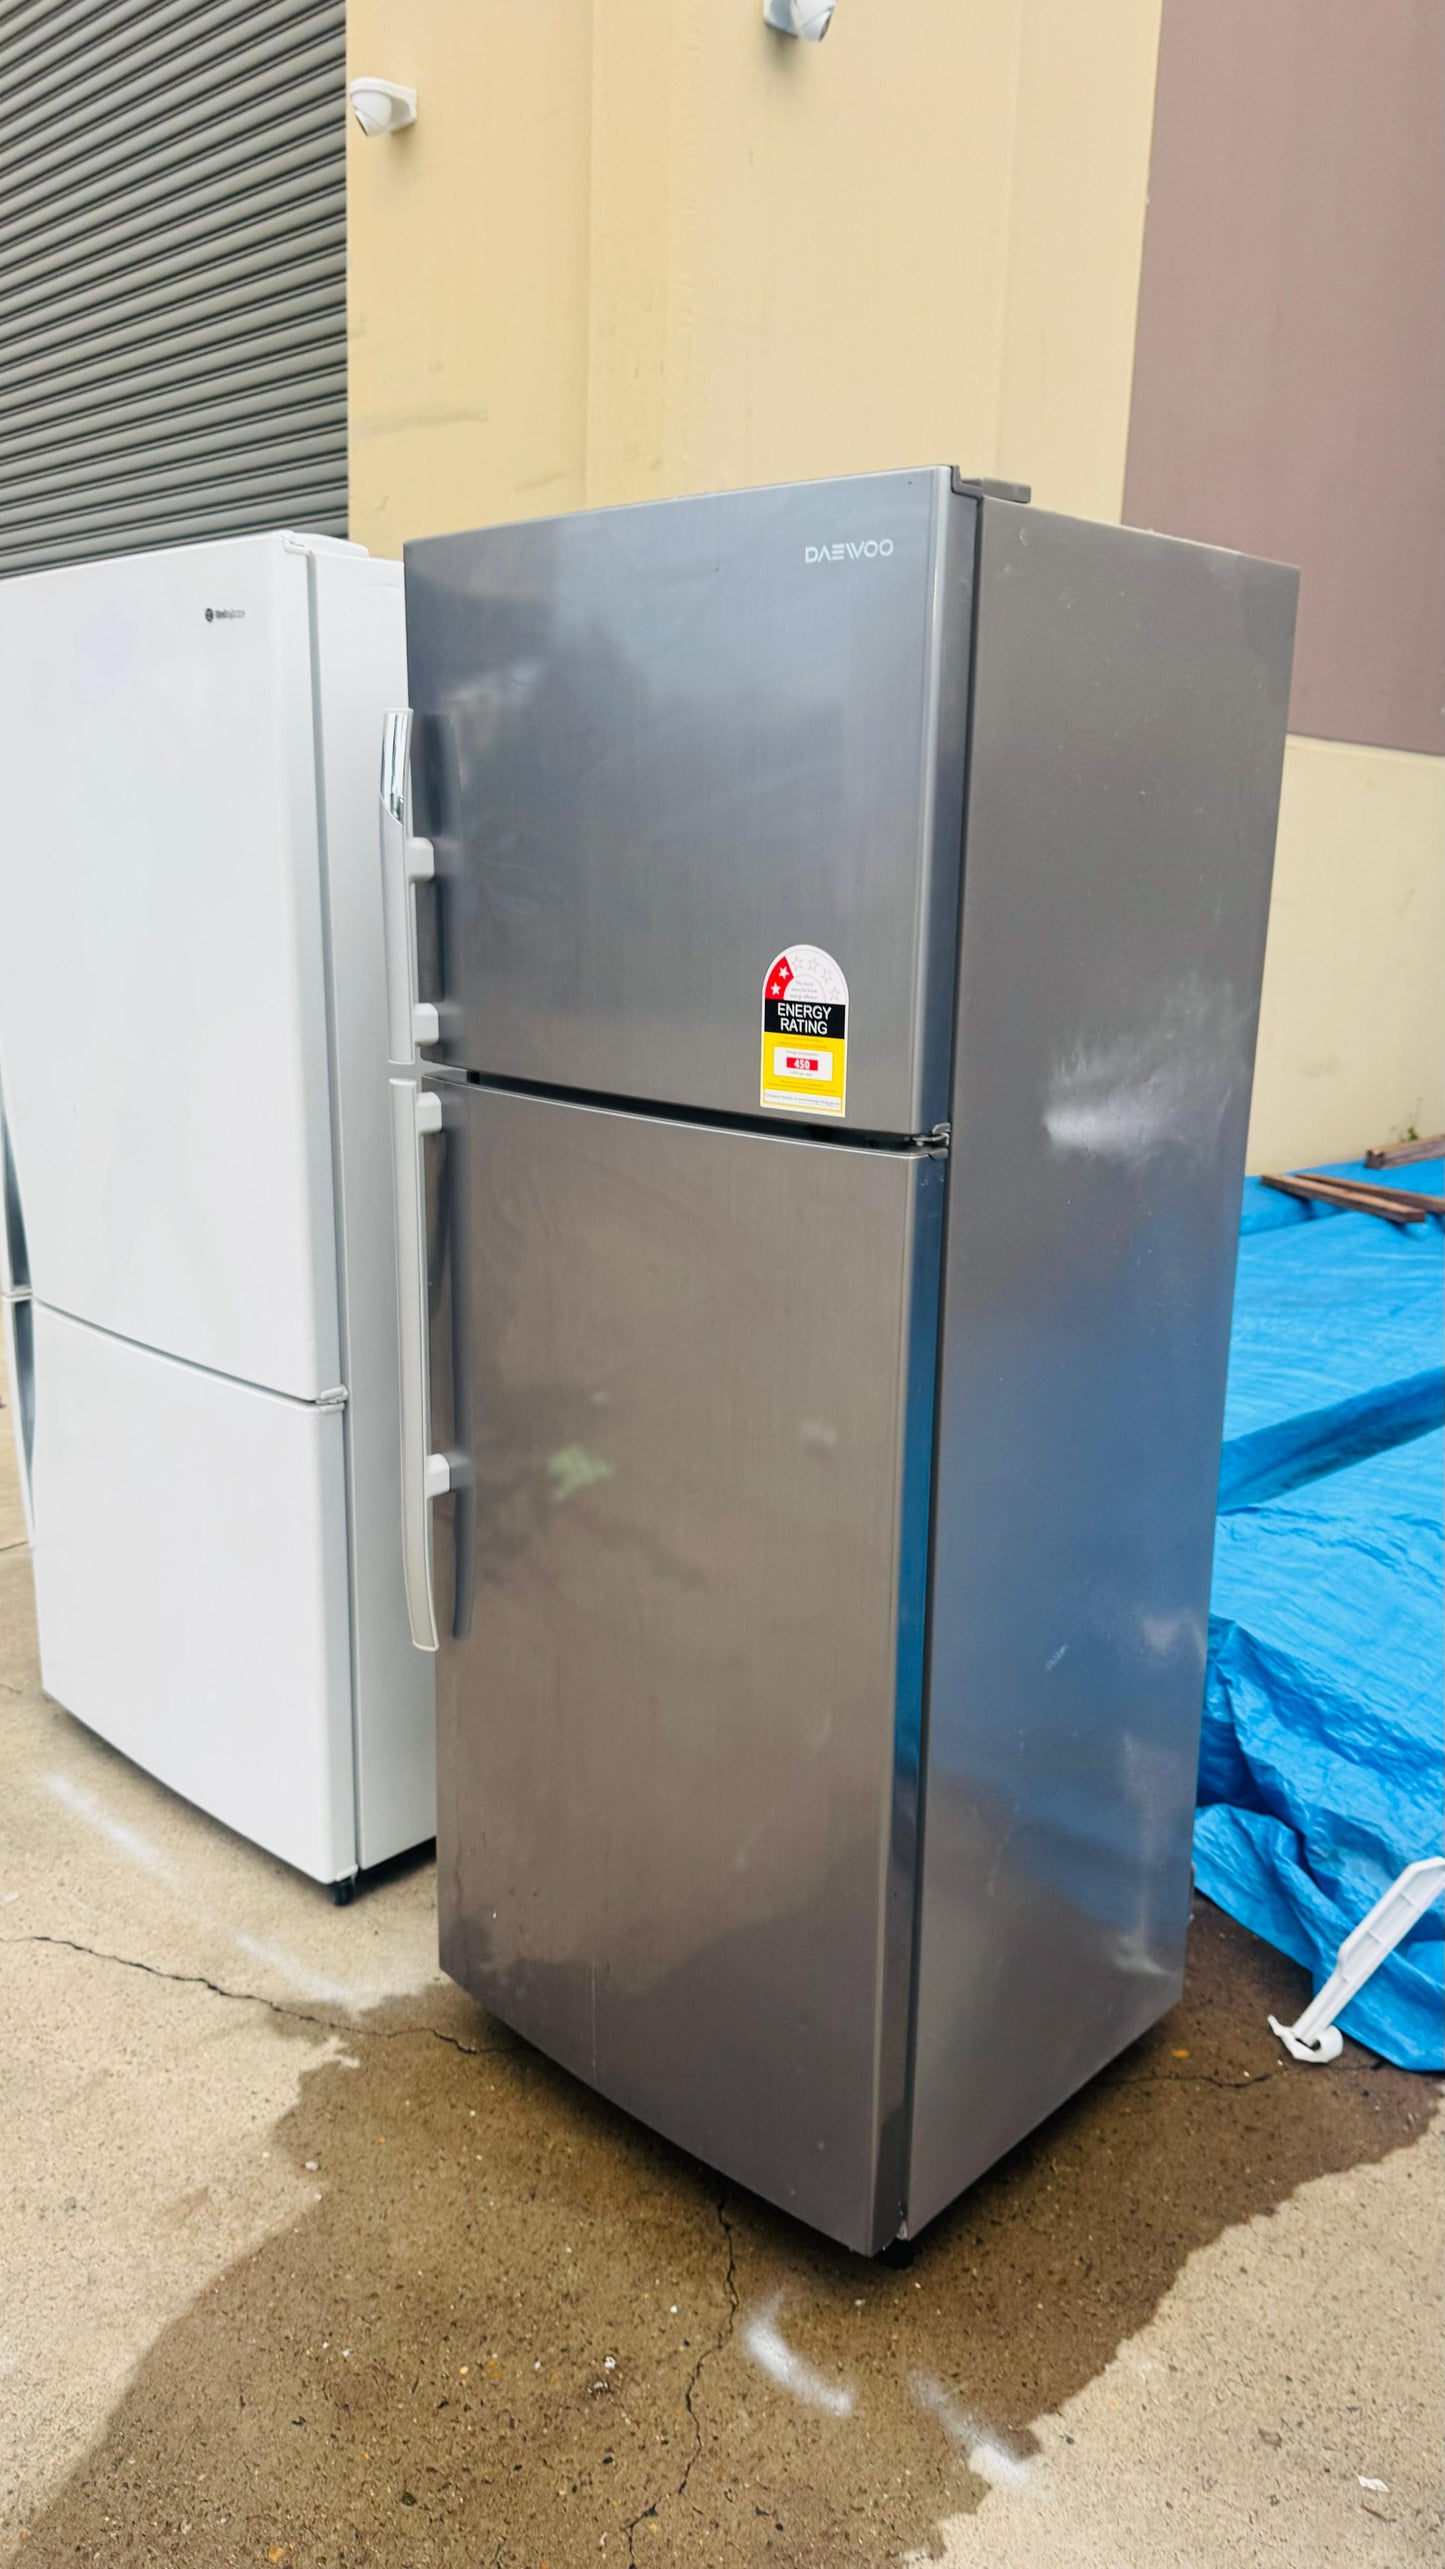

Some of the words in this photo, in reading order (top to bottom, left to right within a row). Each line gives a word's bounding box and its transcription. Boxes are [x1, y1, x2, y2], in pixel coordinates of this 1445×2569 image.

[805, 538, 894, 564] DAEWOO
[777, 1003, 832, 1020] ENERGY
[780, 1017, 828, 1035] RATING
